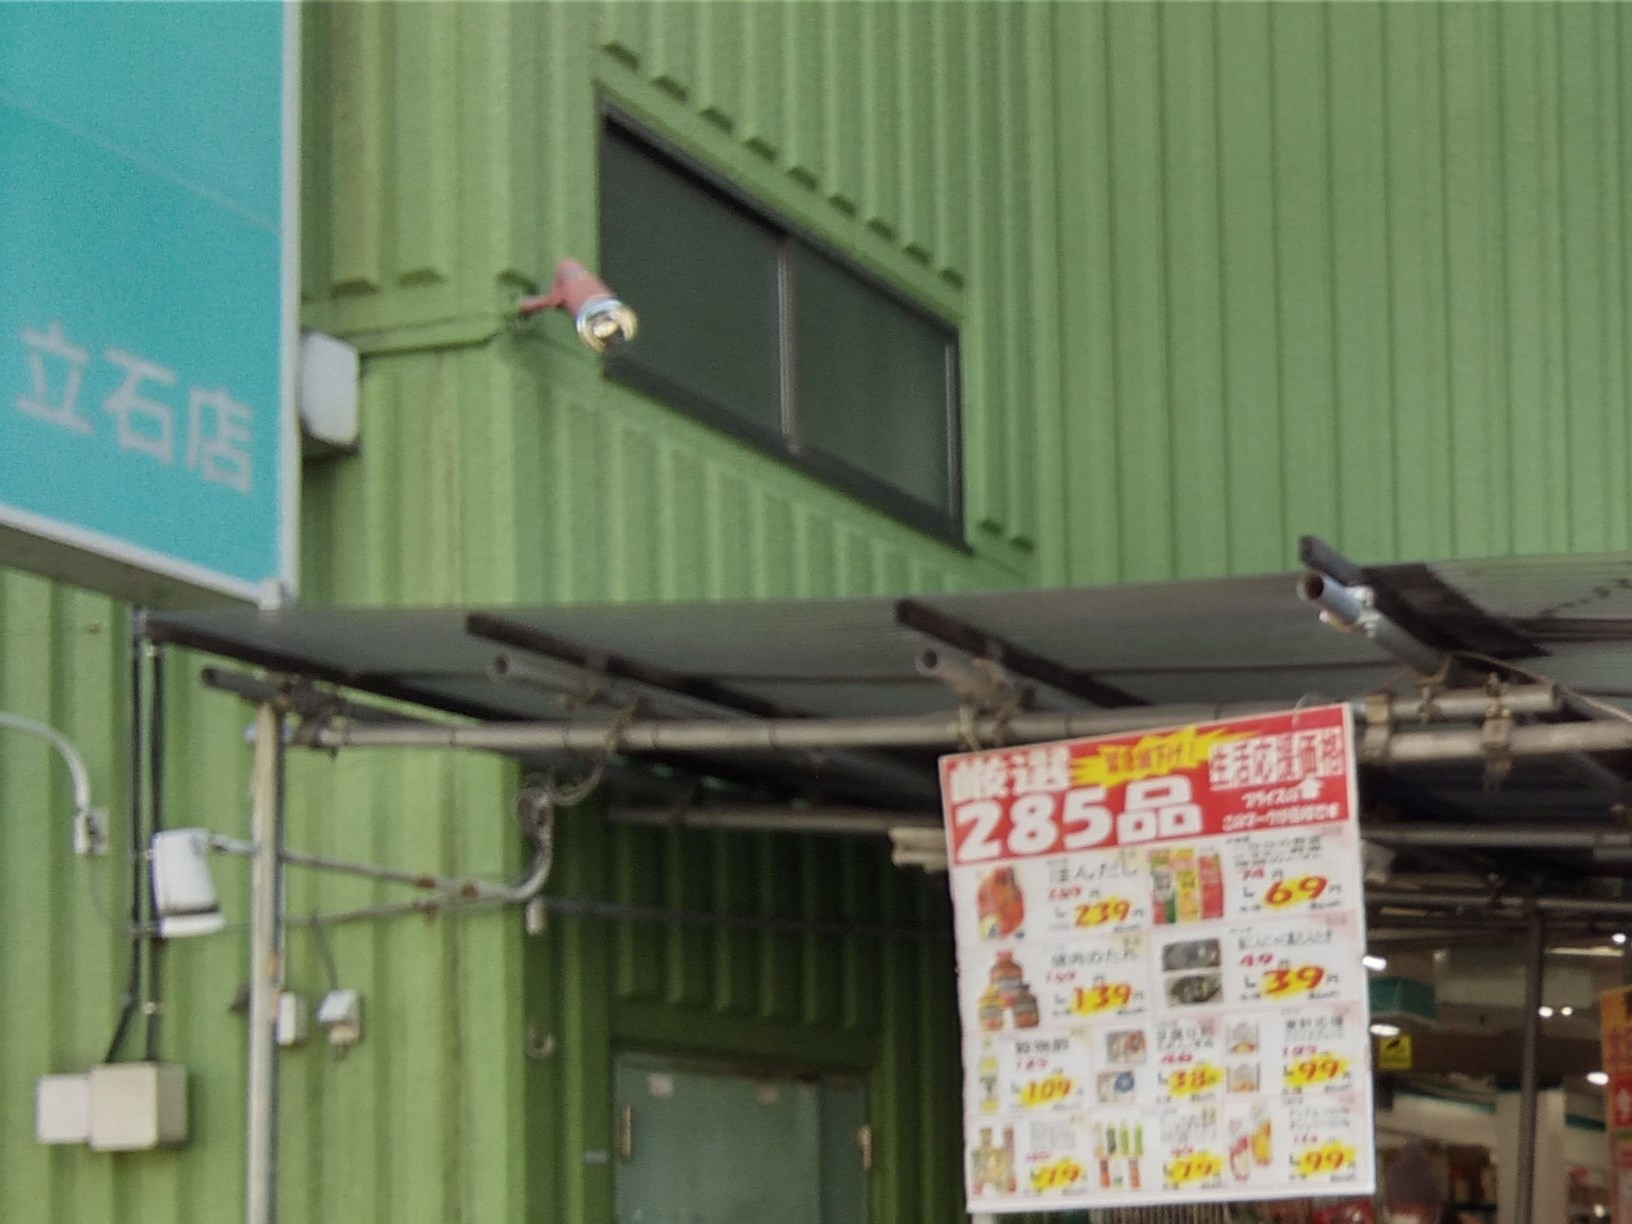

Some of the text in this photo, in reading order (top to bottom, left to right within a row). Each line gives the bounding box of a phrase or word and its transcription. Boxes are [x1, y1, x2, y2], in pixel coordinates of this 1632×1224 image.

[15, 320, 253, 496] 立石店
[956, 775, 1203, 864] 285品
[1264, 876, 1328, 906] 69
[1074, 900, 1131, 928] 239
[1263, 965, 1325, 995] 39
[1074, 982, 1132, 1013] 139
